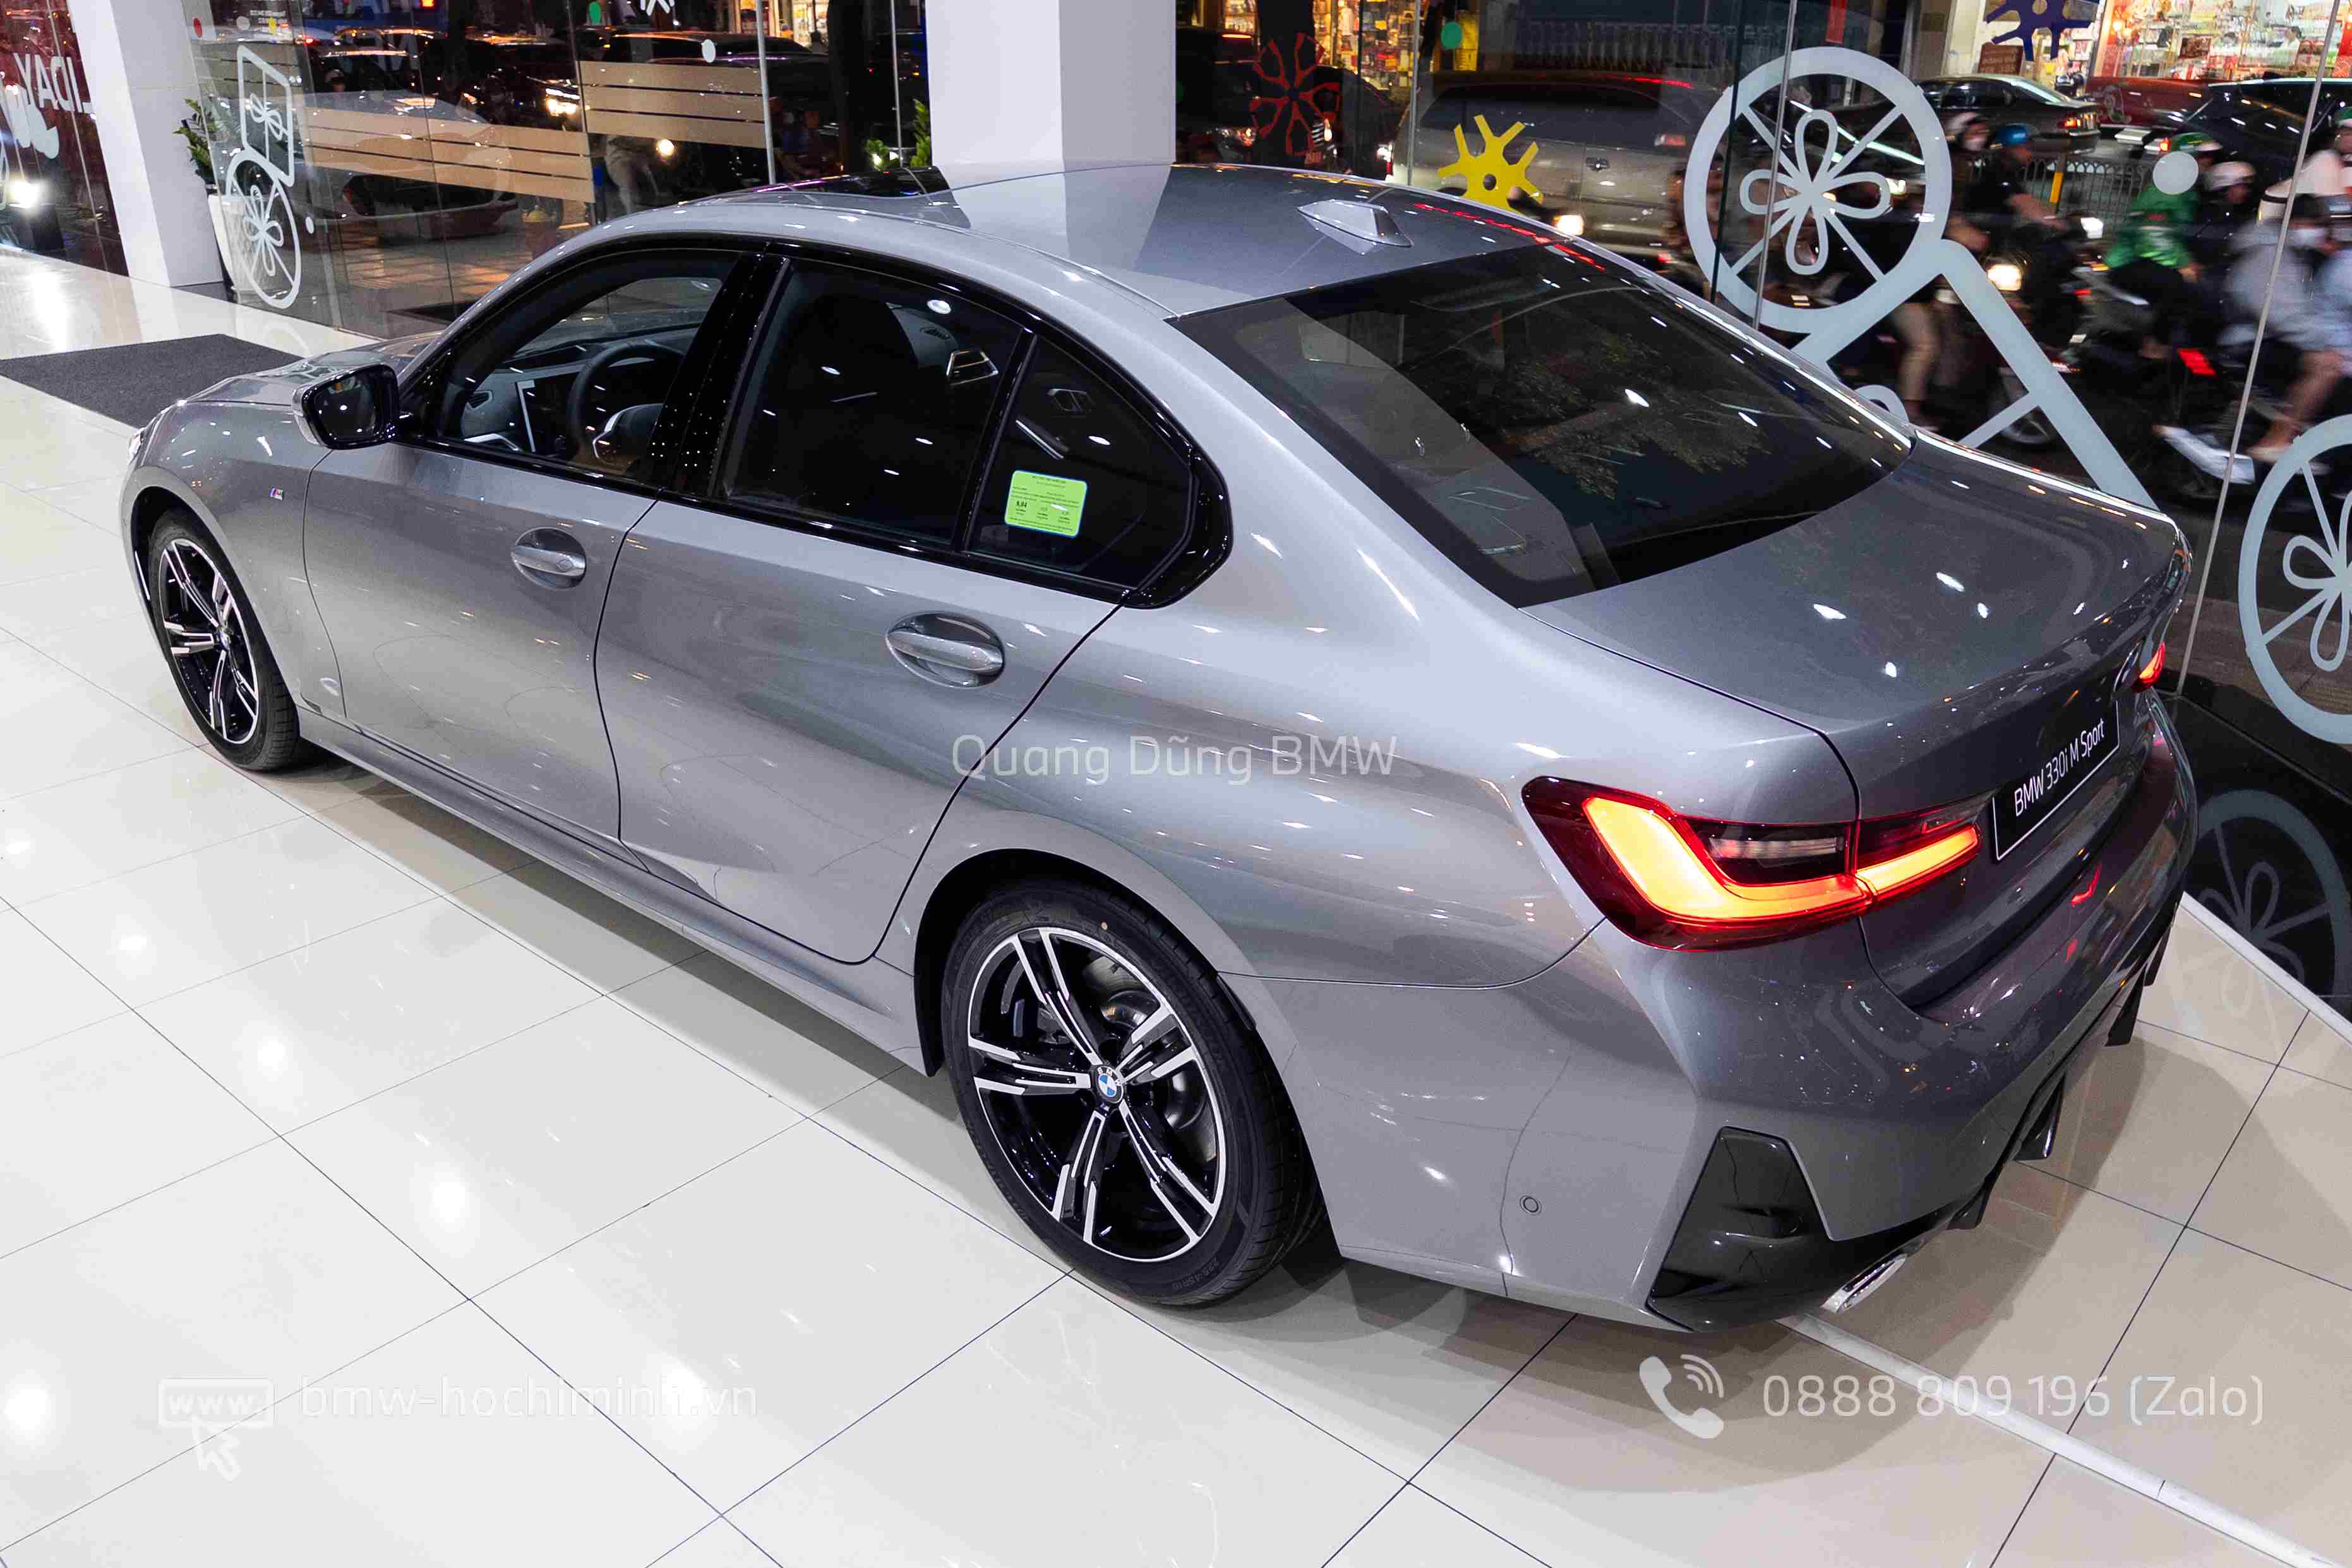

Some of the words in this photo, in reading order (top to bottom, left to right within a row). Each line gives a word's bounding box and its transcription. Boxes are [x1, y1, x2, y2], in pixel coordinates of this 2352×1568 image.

[2013, 768, 2044, 817] BMW
[2046, 748, 2069, 791] 330i
[2070, 738, 2080, 768] M
[2080, 717, 2105, 758] Sport
